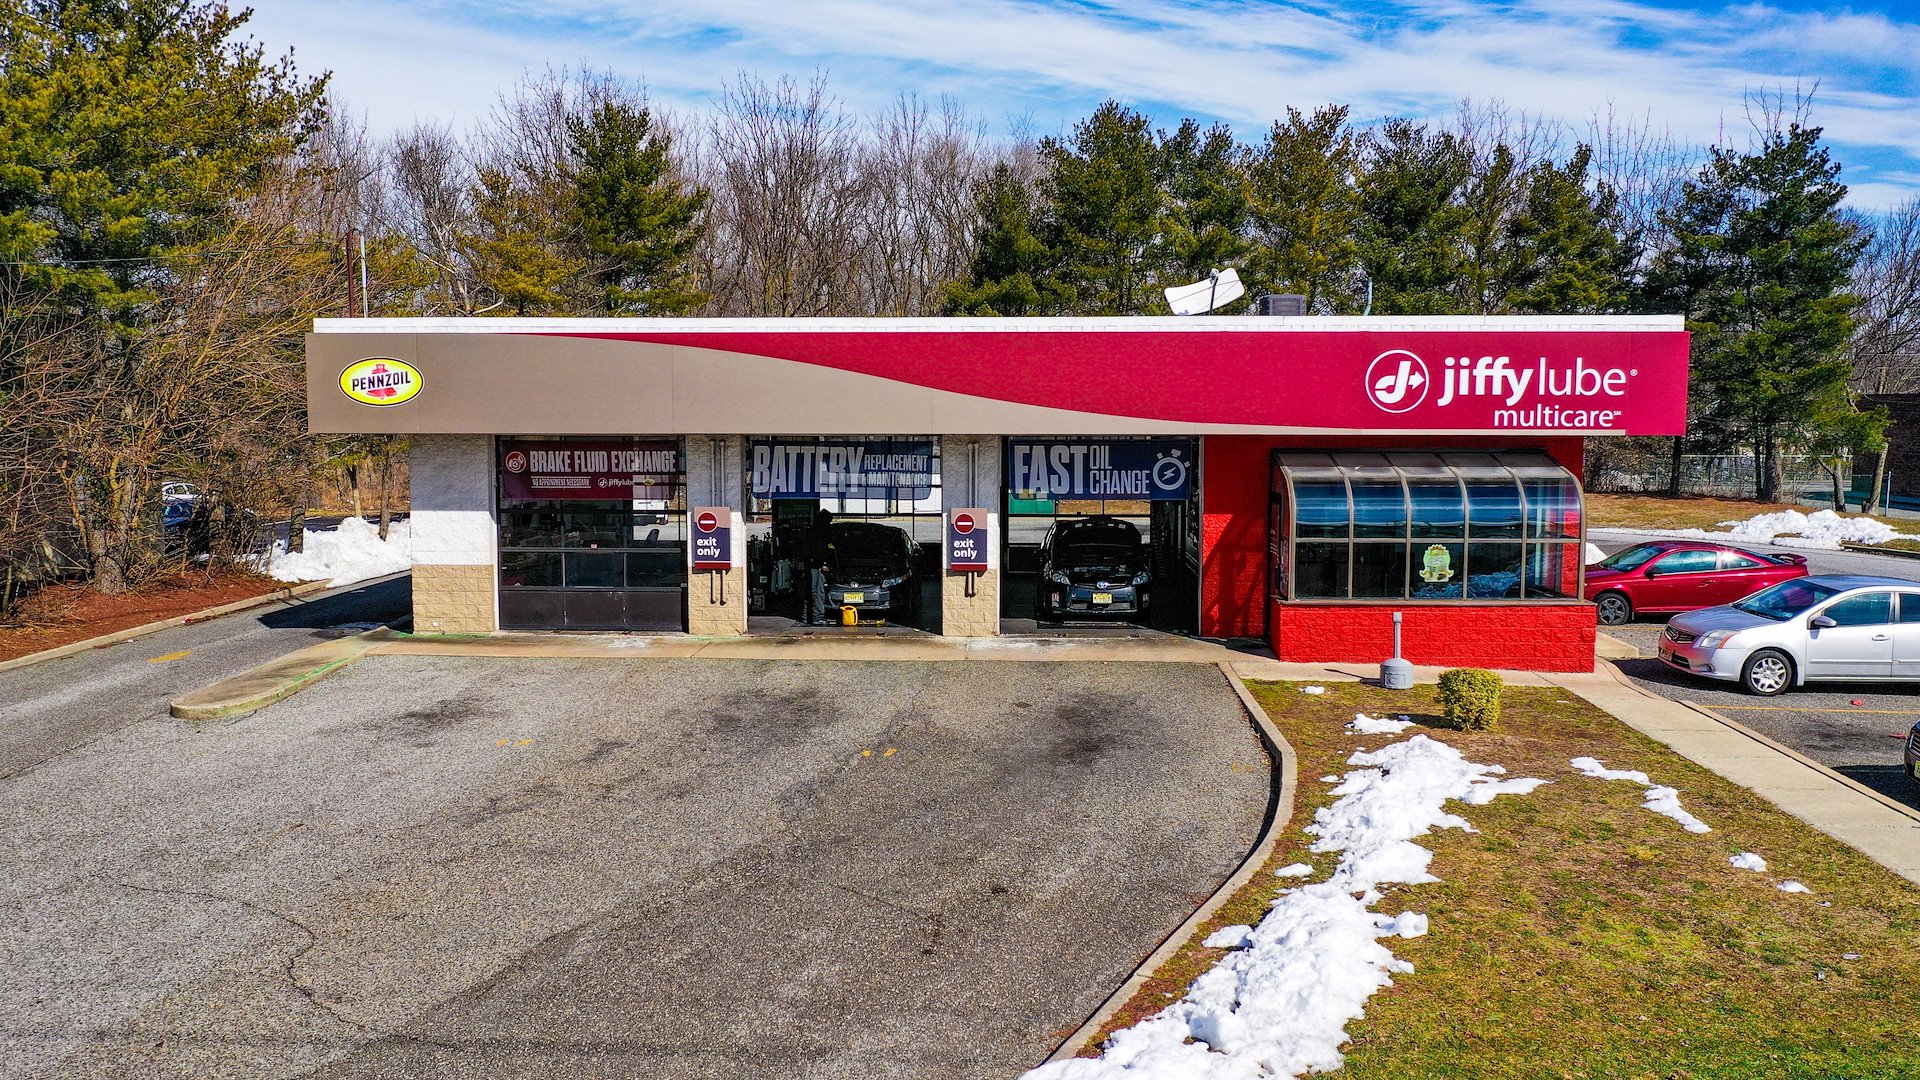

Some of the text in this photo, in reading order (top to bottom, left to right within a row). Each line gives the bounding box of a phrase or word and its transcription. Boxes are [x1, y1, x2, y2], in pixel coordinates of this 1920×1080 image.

[352, 371, 411, 391] PENNZOIL
[530, 450, 676, 473] BRAKE FLUID EXCHANGE
[864, 454, 928, 472] REPLACEMENT
[1089, 445, 1113, 470] OIL
[753, 445, 865, 494] BATTERY
[1014, 445, 1088, 495] FAST
[867, 471, 928, 488] MAINTENANCE
[1089, 470, 1150, 495] CHANGE
[696, 536, 717, 547] exit
[953, 538, 974, 548] exit
[696, 545, 721, 558] only
[953, 547, 978, 560] only
